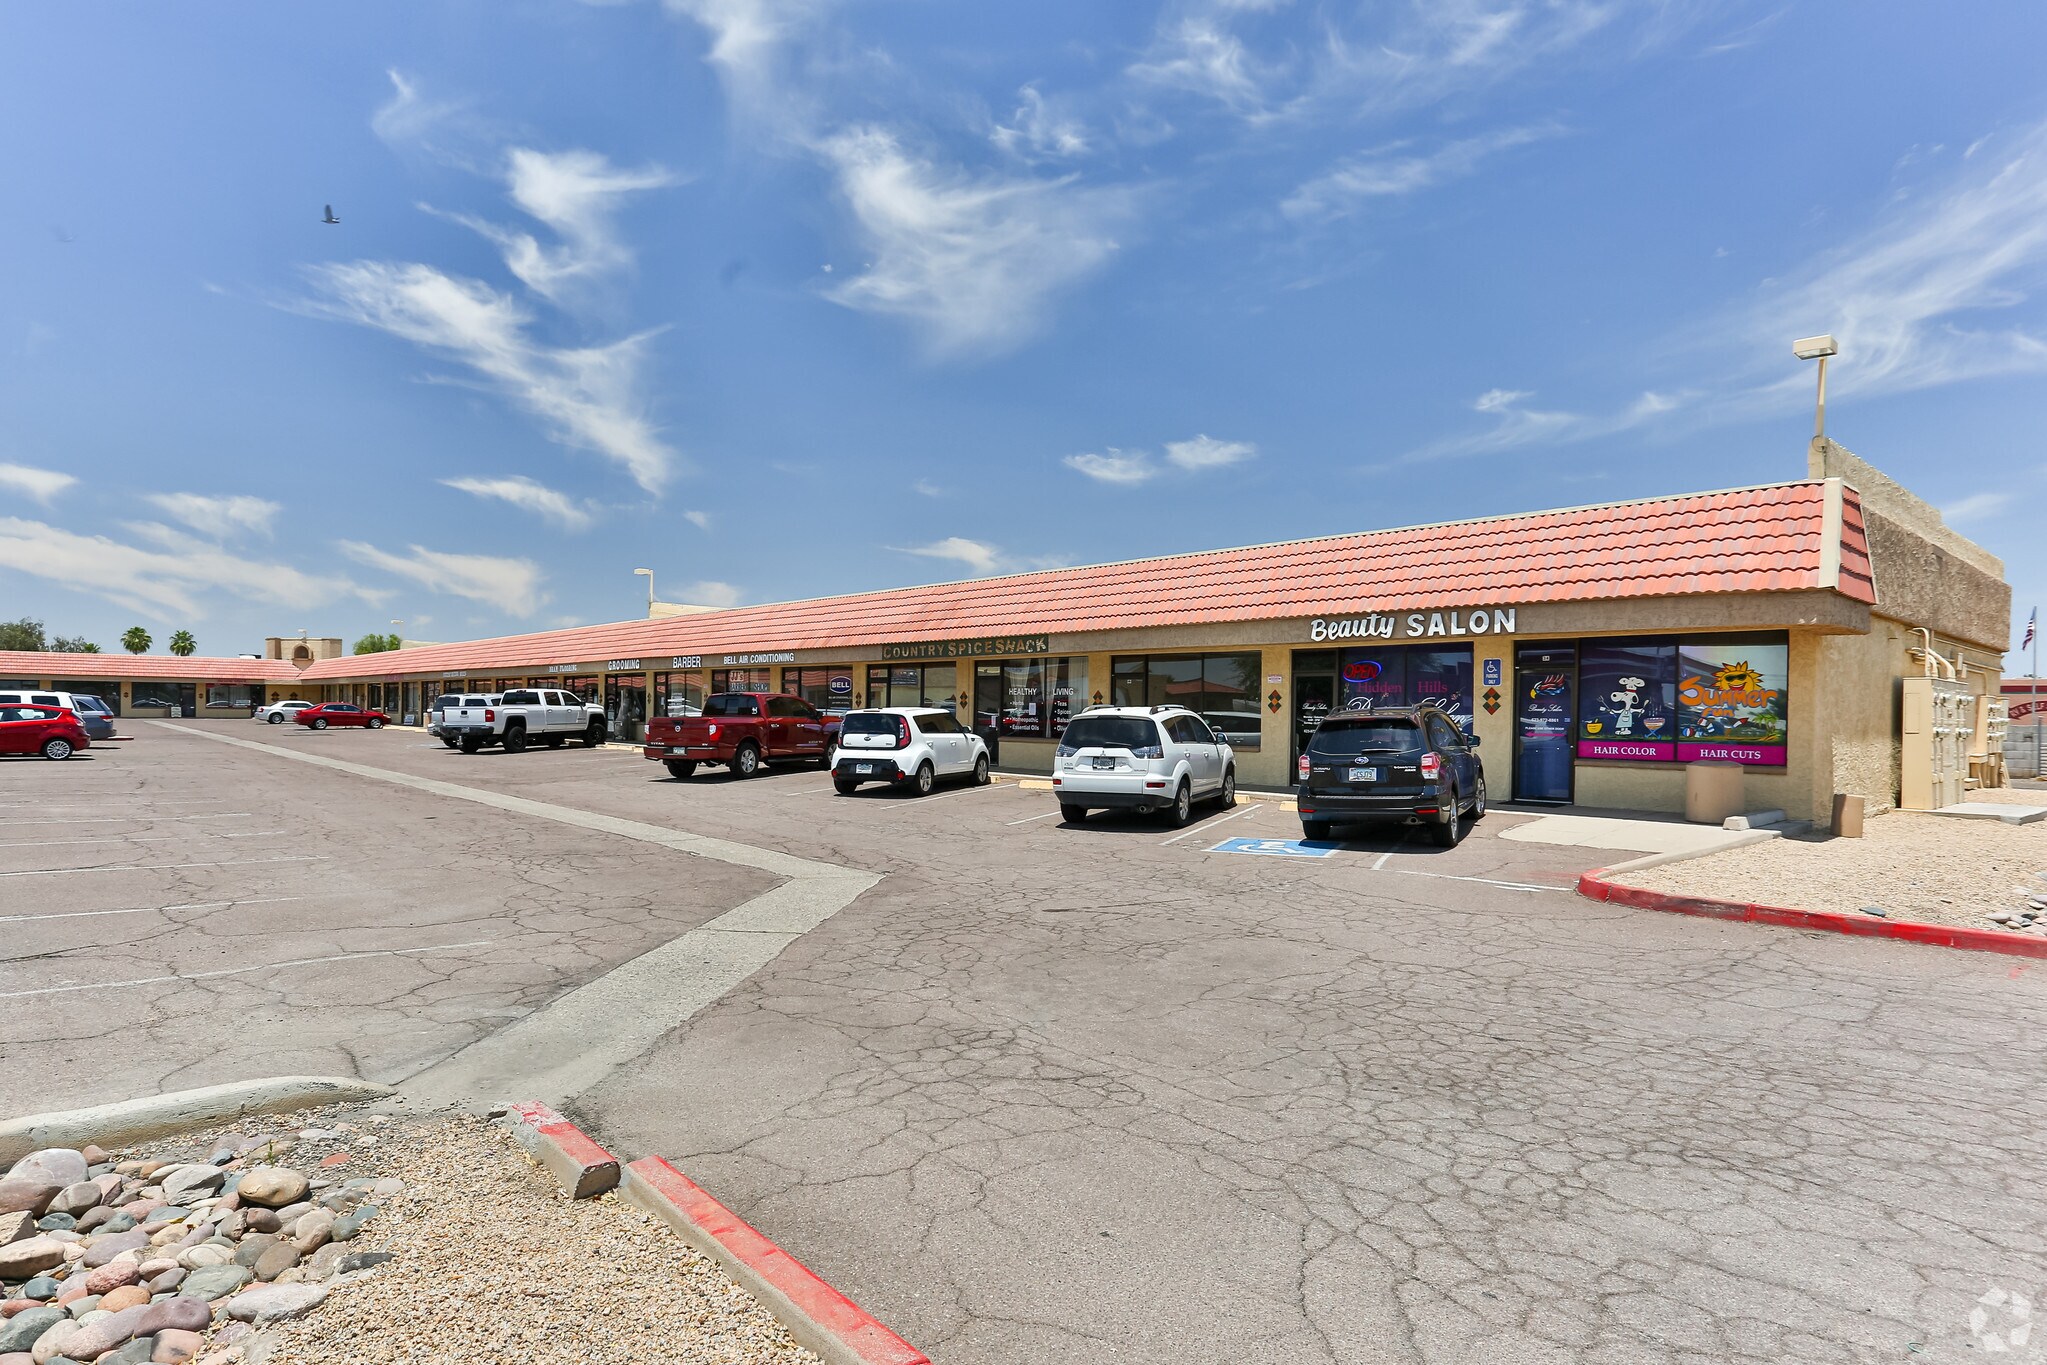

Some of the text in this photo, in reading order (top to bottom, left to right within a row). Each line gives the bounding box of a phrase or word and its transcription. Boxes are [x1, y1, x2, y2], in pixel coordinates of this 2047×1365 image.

[1310, 608, 1516, 642] Beauty SALON
[883, 637, 1047, 659] COUNTRY SPICE SHACK
[607, 658, 640, 671] GROOMING
[672, 656, 702, 668] BARBER
[723, 652, 795, 665] BELL AIR CONDITIONING
[1343, 663, 1378, 679] OPEN
[1008, 687, 1074, 696] HEALTHY LIVING
[1357, 681, 1448, 693] Hidden Hills
[1594, 746, 1657, 756] HAIR COLOR
[1700, 749, 1761, 759] HAIR CUTS
